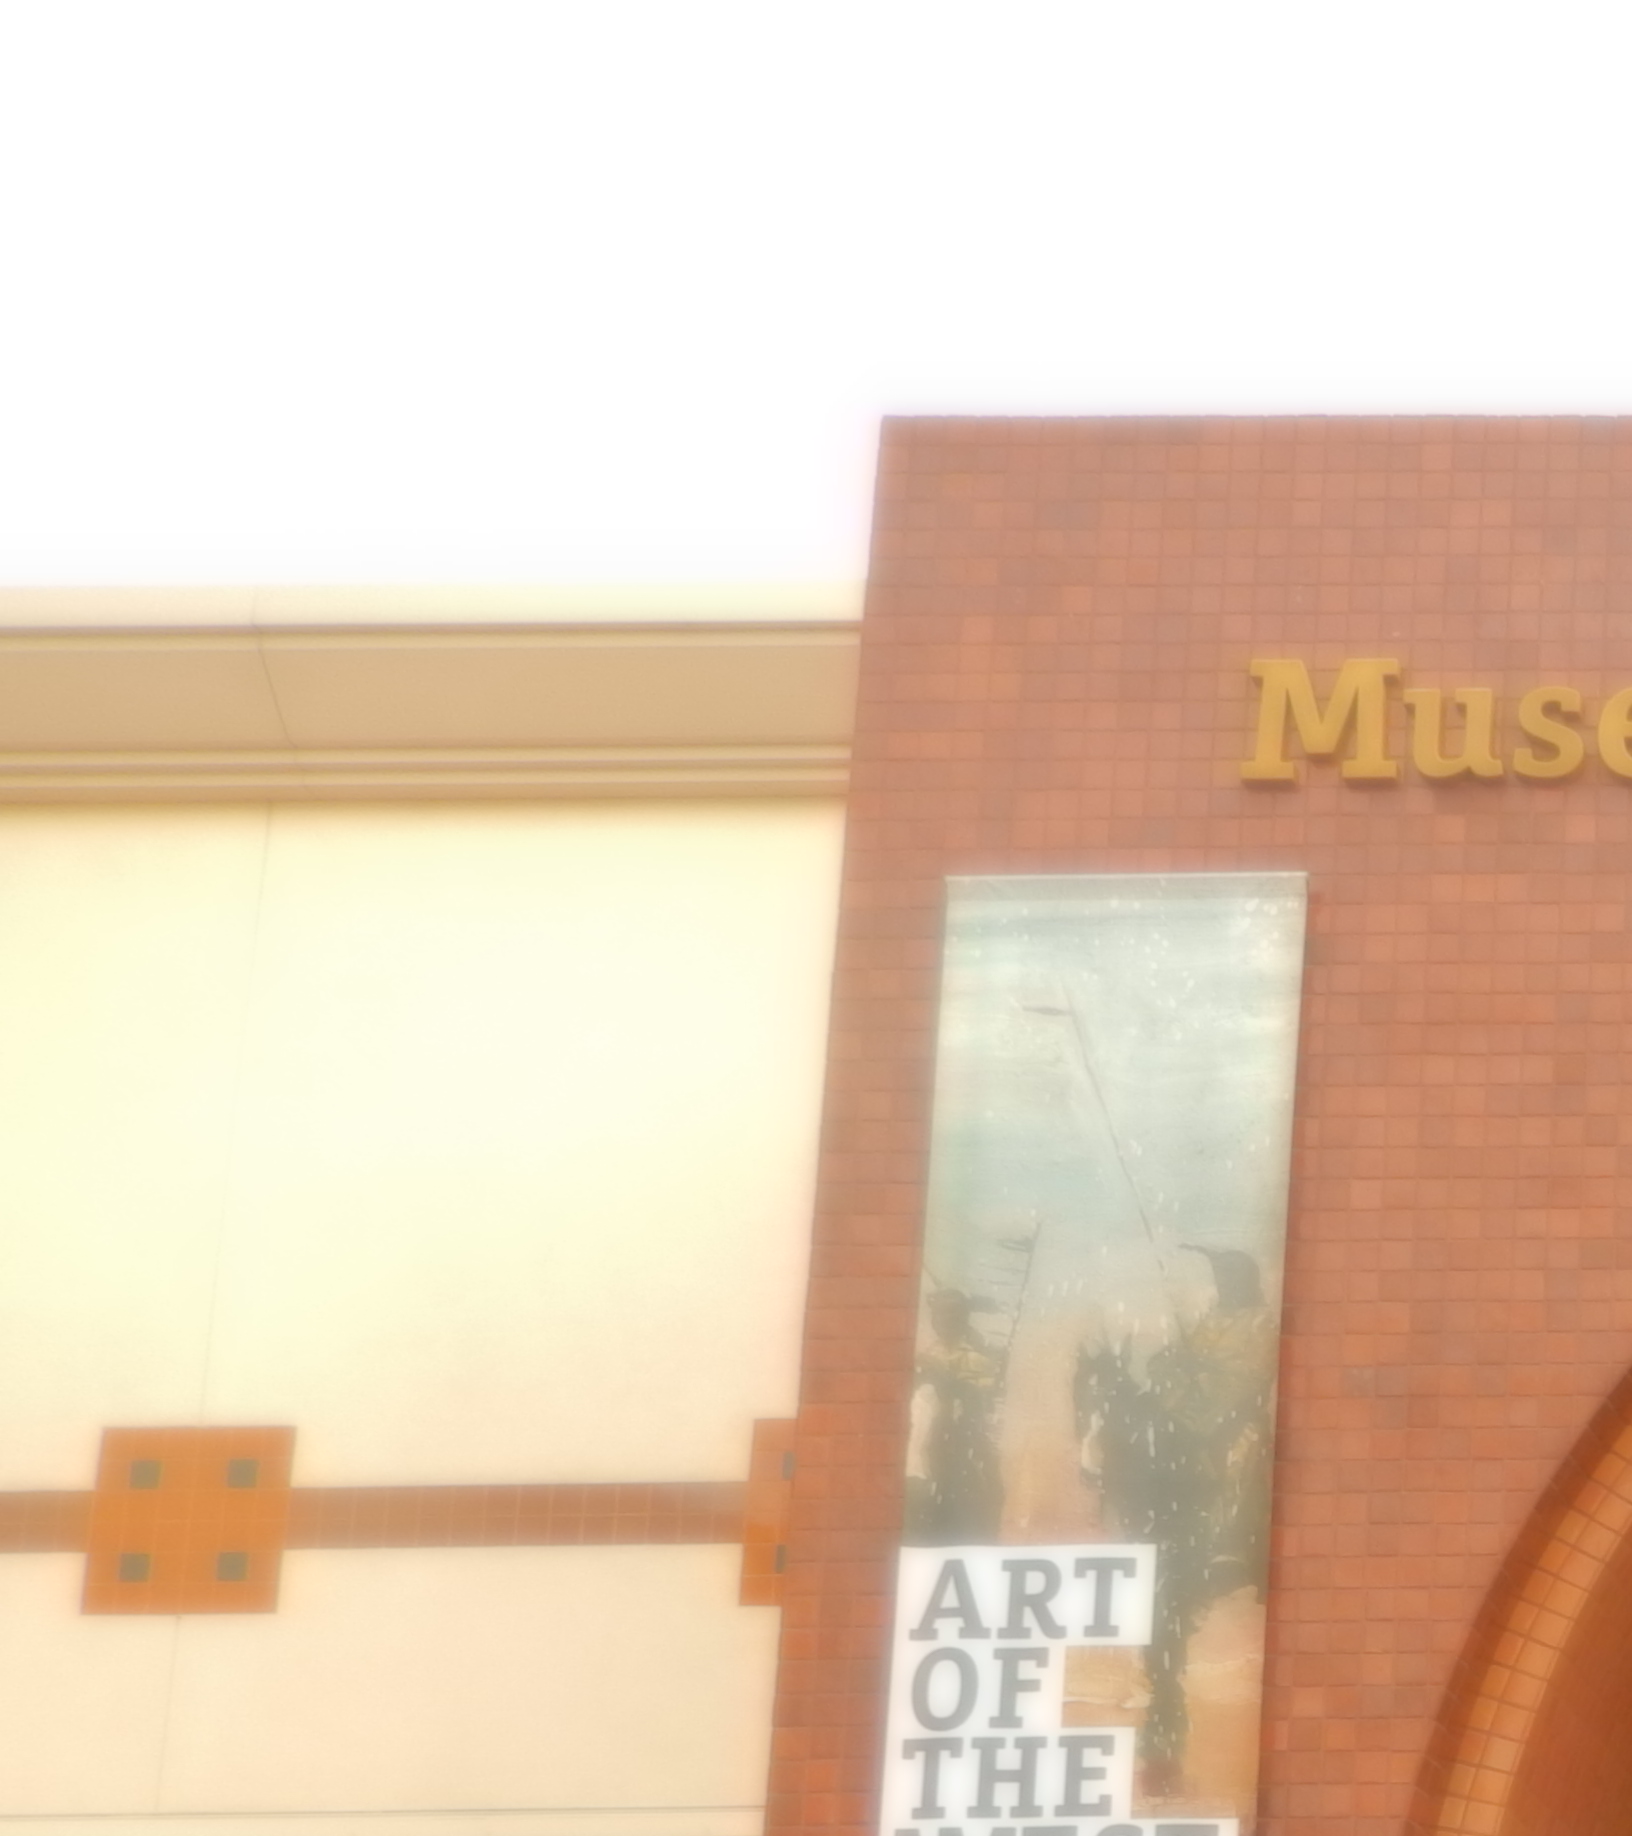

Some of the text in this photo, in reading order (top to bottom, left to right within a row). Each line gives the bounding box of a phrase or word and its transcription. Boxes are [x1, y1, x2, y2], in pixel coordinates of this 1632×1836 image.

[908, 1556, 1137, 1641] ART
[910, 1646, 1050, 1732] OF
[901, 1734, 1115, 1820] THE
